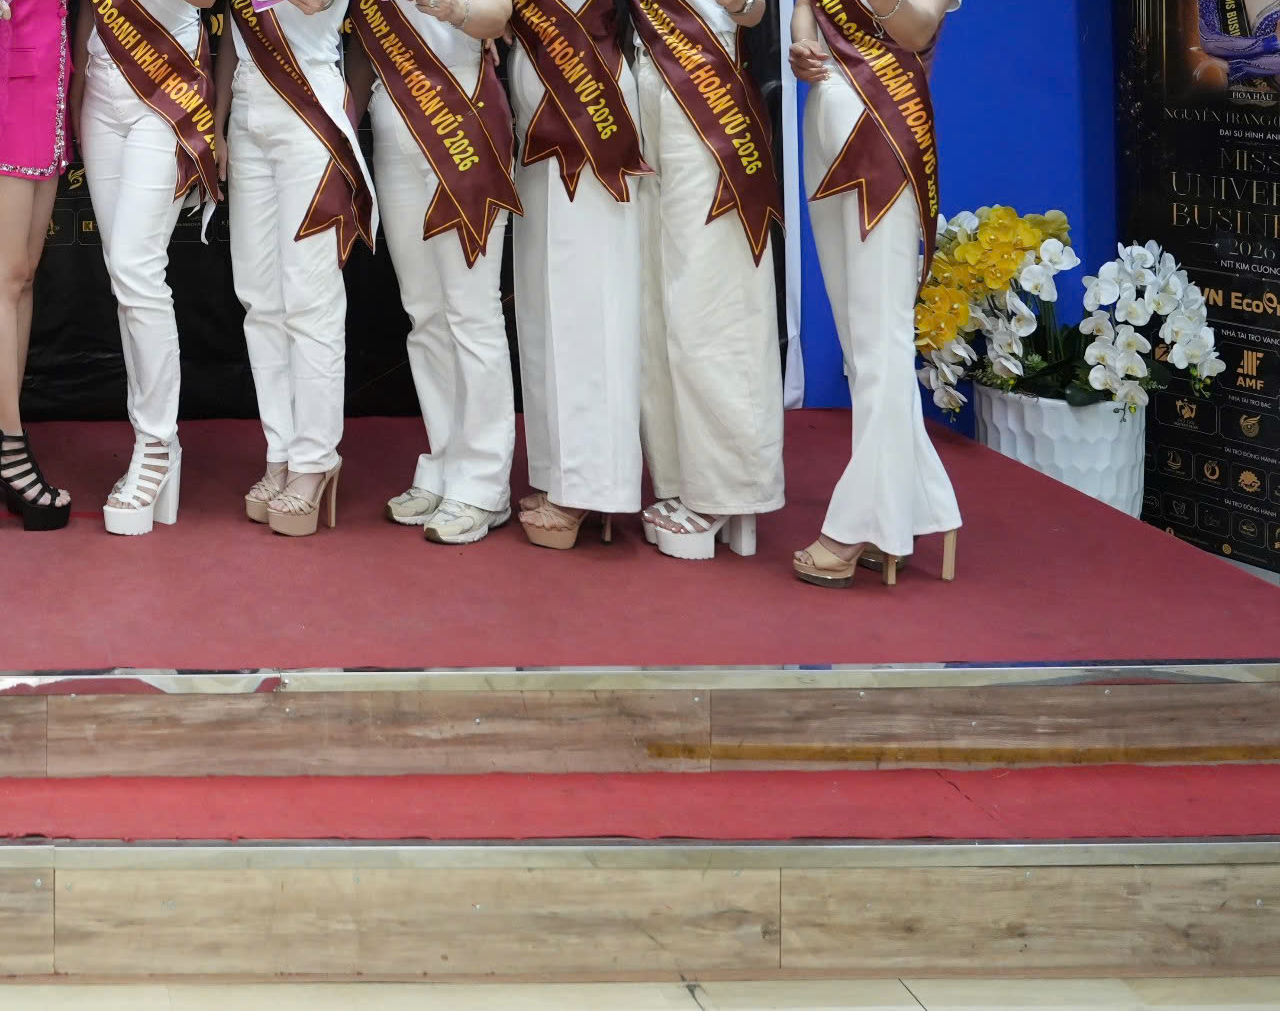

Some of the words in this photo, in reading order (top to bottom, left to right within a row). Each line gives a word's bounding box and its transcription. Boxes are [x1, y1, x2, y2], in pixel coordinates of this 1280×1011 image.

[380, 32, 418, 77] NHÂN
[547, 35, 588, 85] HOÀN
[663, 27, 707, 73] NHÂN
[130, 40, 172, 85] NHÂN
[161, 73, 205, 114] HOÀN
[405, 71, 443, 117] HOÀN
[574, 74, 605, 104] VŨ
[690, 64, 734, 116] HOÀN
[1232, 91, 1251, 100] HOA
[430, 107, 465, 136] VŨ
[587, 97, 618, 141] 2026
[719, 105, 751, 136] VŨ
[869, 50, 917, 103] NHÂN
[898, 93, 933, 150] HOÀN
[443, 130, 480, 172] 2026
[732, 131, 763, 176] 2026
[1235, 261, 1250, 271] KIM
[1236, 376, 1265, 390] AMF
